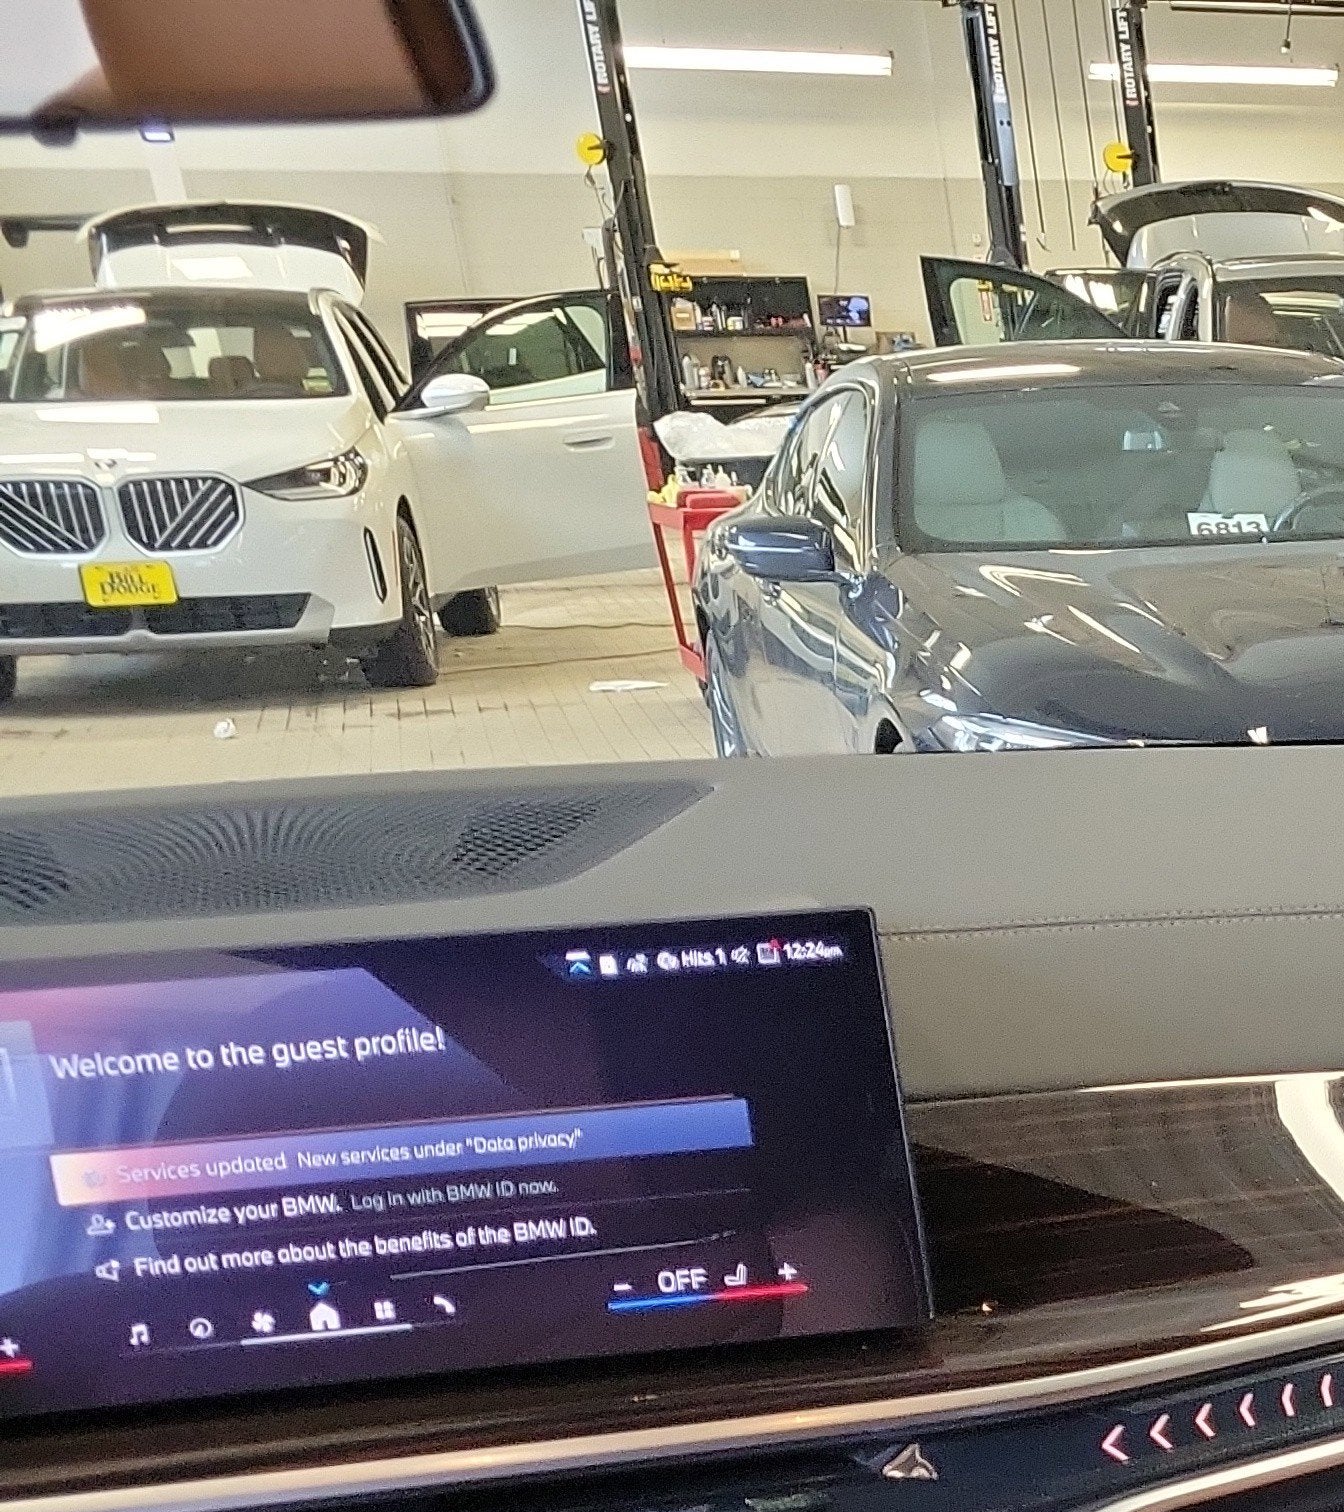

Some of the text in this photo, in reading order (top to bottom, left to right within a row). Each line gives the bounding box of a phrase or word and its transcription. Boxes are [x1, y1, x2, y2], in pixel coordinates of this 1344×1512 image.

[587, 23, 609, 84] ROTARY
[984, 3, 1005, 93] ROTARY LIFT
[1117, 9, 1138, 98] ROTARY LIFT
[1197, 521, 1261, 536] 6813
[50, 1026, 448, 1080] Welcome to the guest profile!
[119, 1152, 287, 1183] Services updated
[297, 1129, 582, 1168] New services under "Data privacy"
[125, 1196, 342, 1231] Customize your BMW.
[351, 1194, 384, 1212] Log
[405, 1188, 444, 1206] with
[446, 1185, 494, 1203] BMW
[496, 1181, 514, 1198] ID
[134, 1215, 597, 1276] Find out more about the benefits of the BMW ID.
[658, 1268, 708, 1292] OFF
